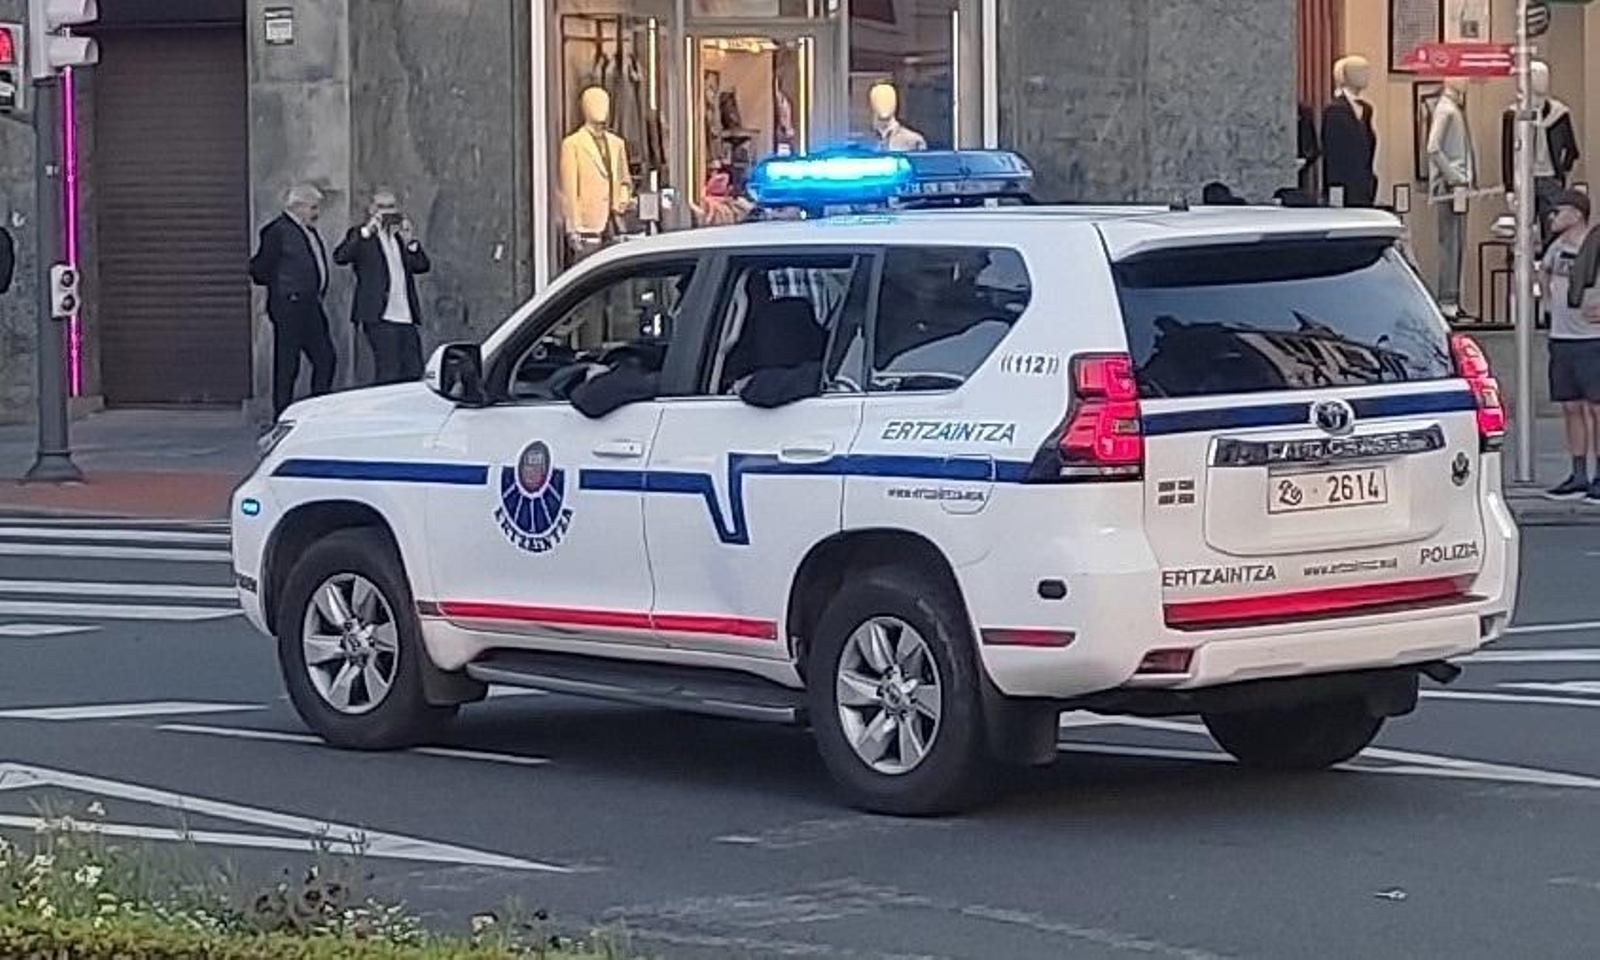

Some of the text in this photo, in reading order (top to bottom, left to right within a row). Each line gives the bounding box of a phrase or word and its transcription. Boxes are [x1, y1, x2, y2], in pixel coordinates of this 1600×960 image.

[1327, 472, 1379, 502] 2614
[1420, 542, 1478, 564] POLIZIA
[1162, 565, 1276, 587] ERTZAINTZA
